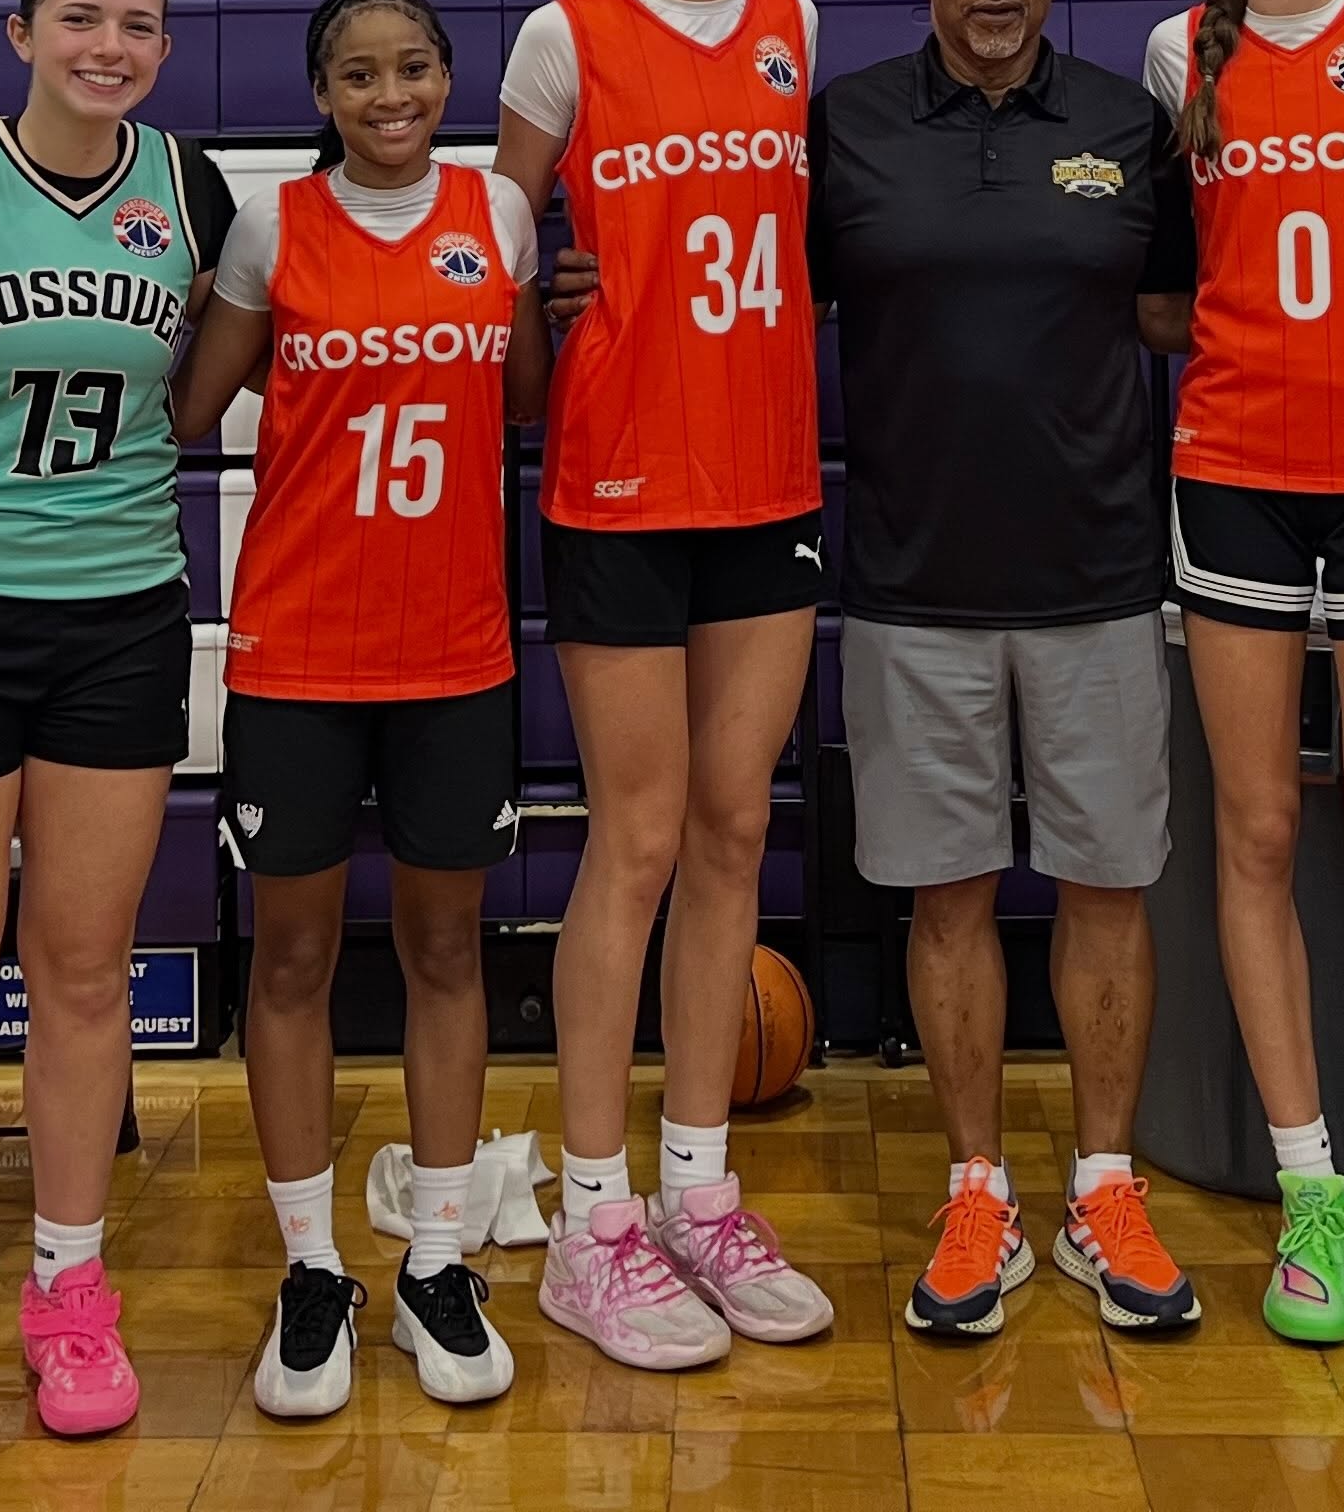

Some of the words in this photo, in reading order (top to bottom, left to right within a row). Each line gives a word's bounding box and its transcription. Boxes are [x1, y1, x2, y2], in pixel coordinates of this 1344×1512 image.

[592, 129, 809, 190] CROSSOVE
[686, 213, 782, 334] 34
[1277, 210, 1331, 320] 0
[281, 323, 511, 371] CROSSOVE
[9, 369, 125, 478] 13
[348, 403, 447, 518] 15
[131, 1017, 191, 1033] QUEST
